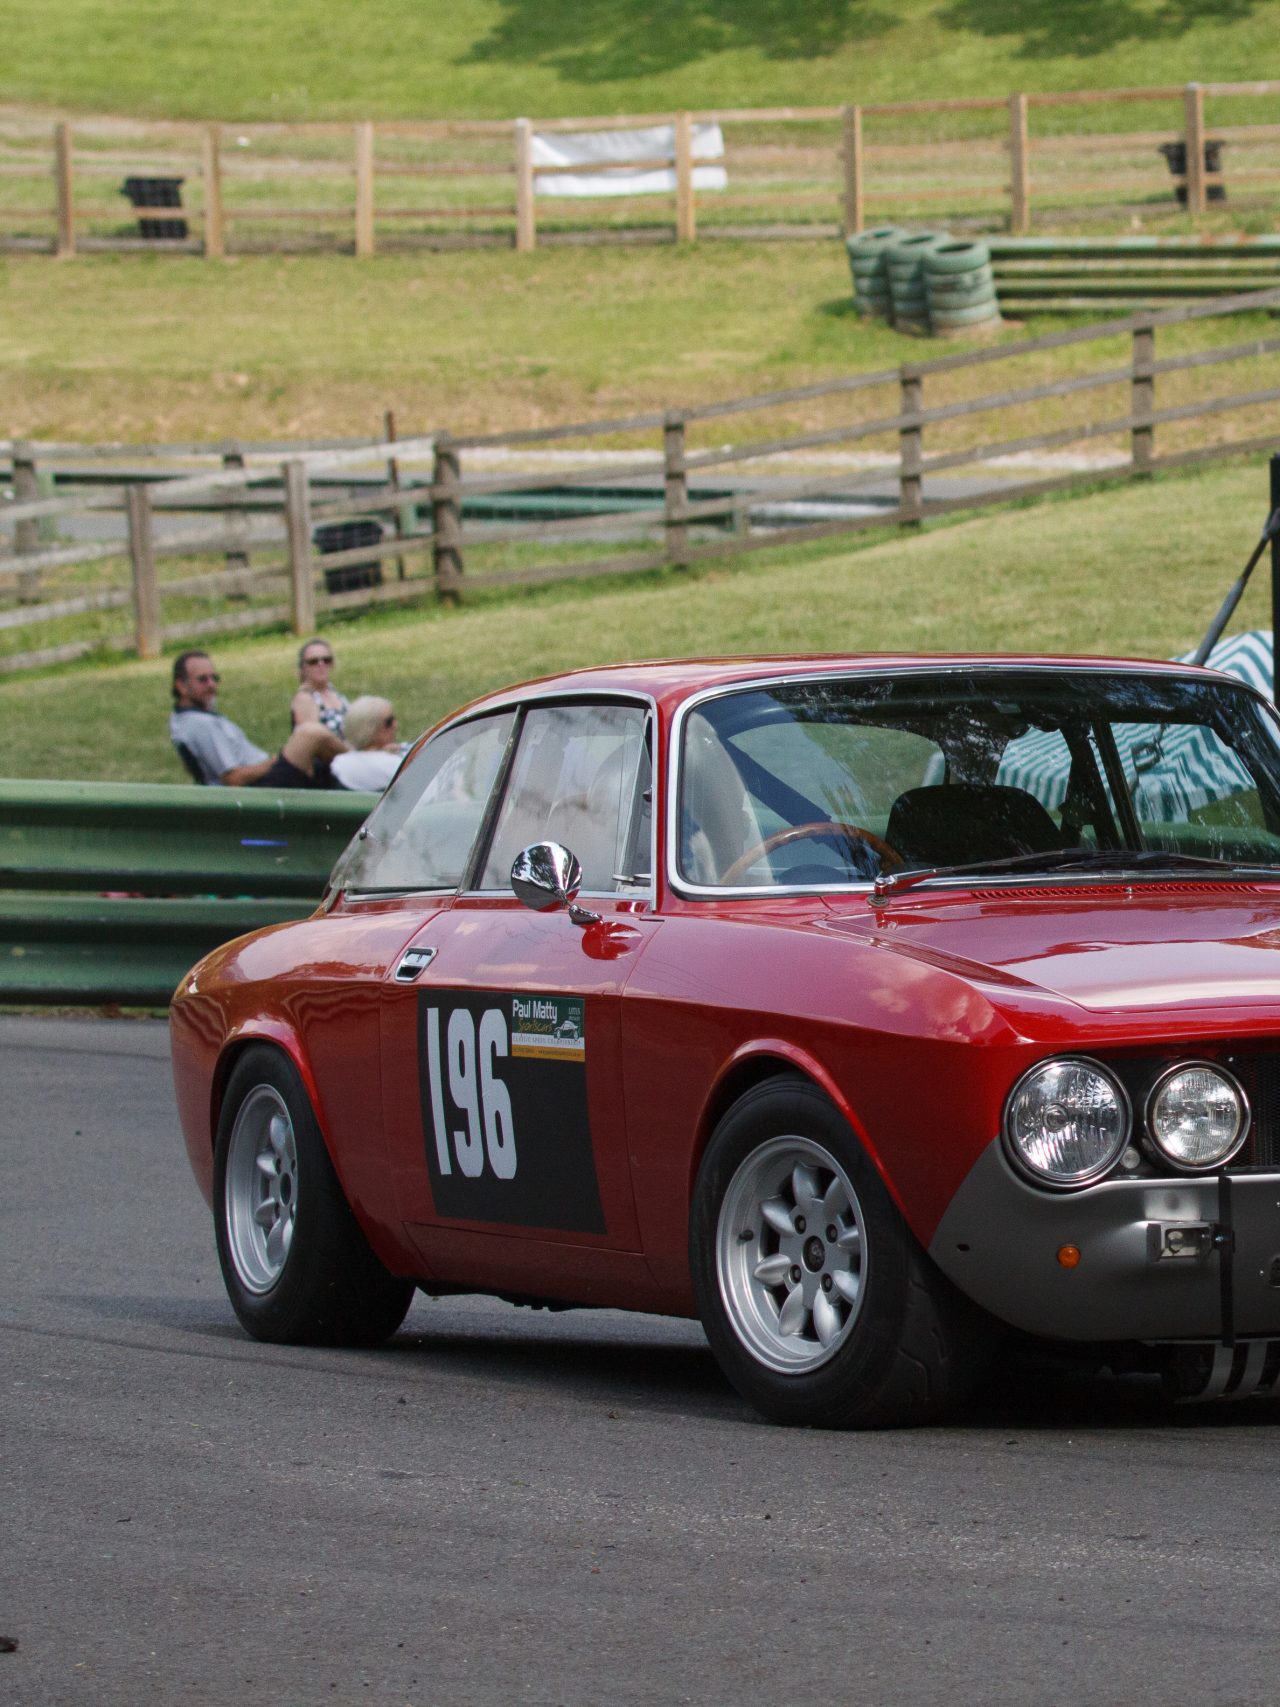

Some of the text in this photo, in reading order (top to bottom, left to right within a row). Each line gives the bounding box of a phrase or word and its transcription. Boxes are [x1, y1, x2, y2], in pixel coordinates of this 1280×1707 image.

[512, 998, 558, 1024] Paul Matty
[427, 1007, 518, 1180] 196
